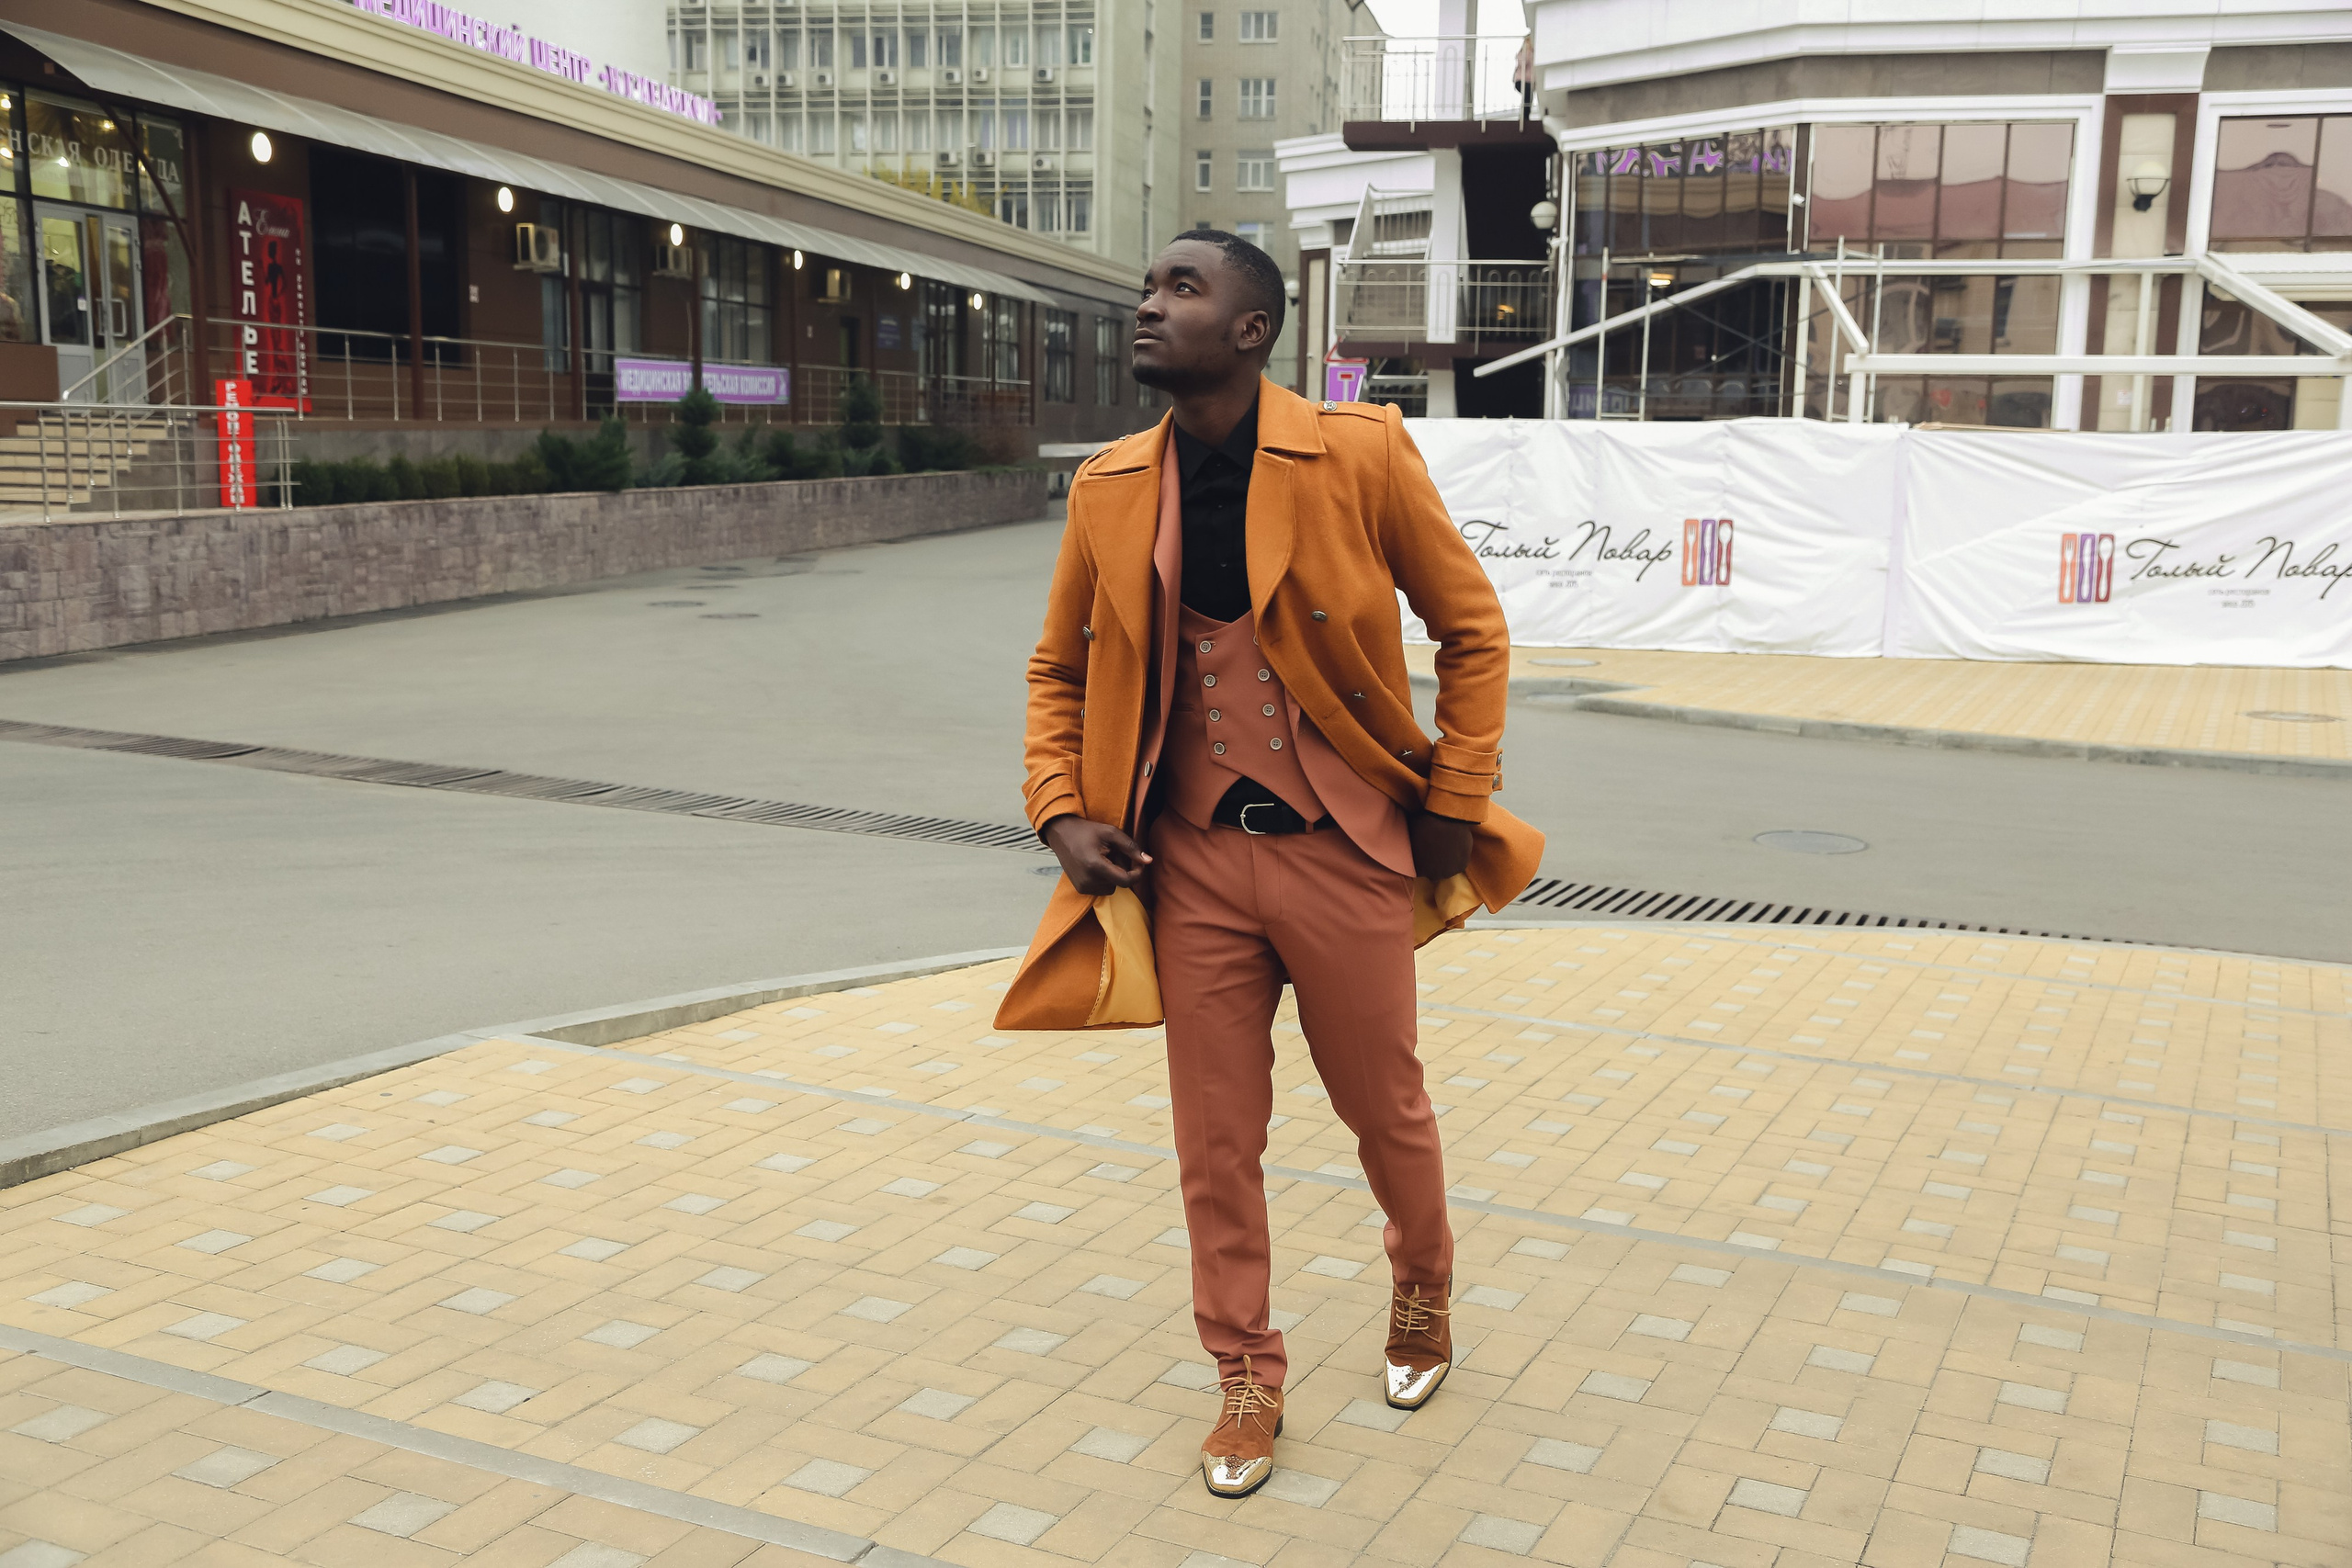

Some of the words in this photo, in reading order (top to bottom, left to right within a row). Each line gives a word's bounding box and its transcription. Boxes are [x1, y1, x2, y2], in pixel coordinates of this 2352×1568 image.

[529, 37, 593, 85] ЦЕНТР
[94, 145, 180, 183] ОДЕДА
[237, 199, 260, 375] АТЕЛЬЕ
